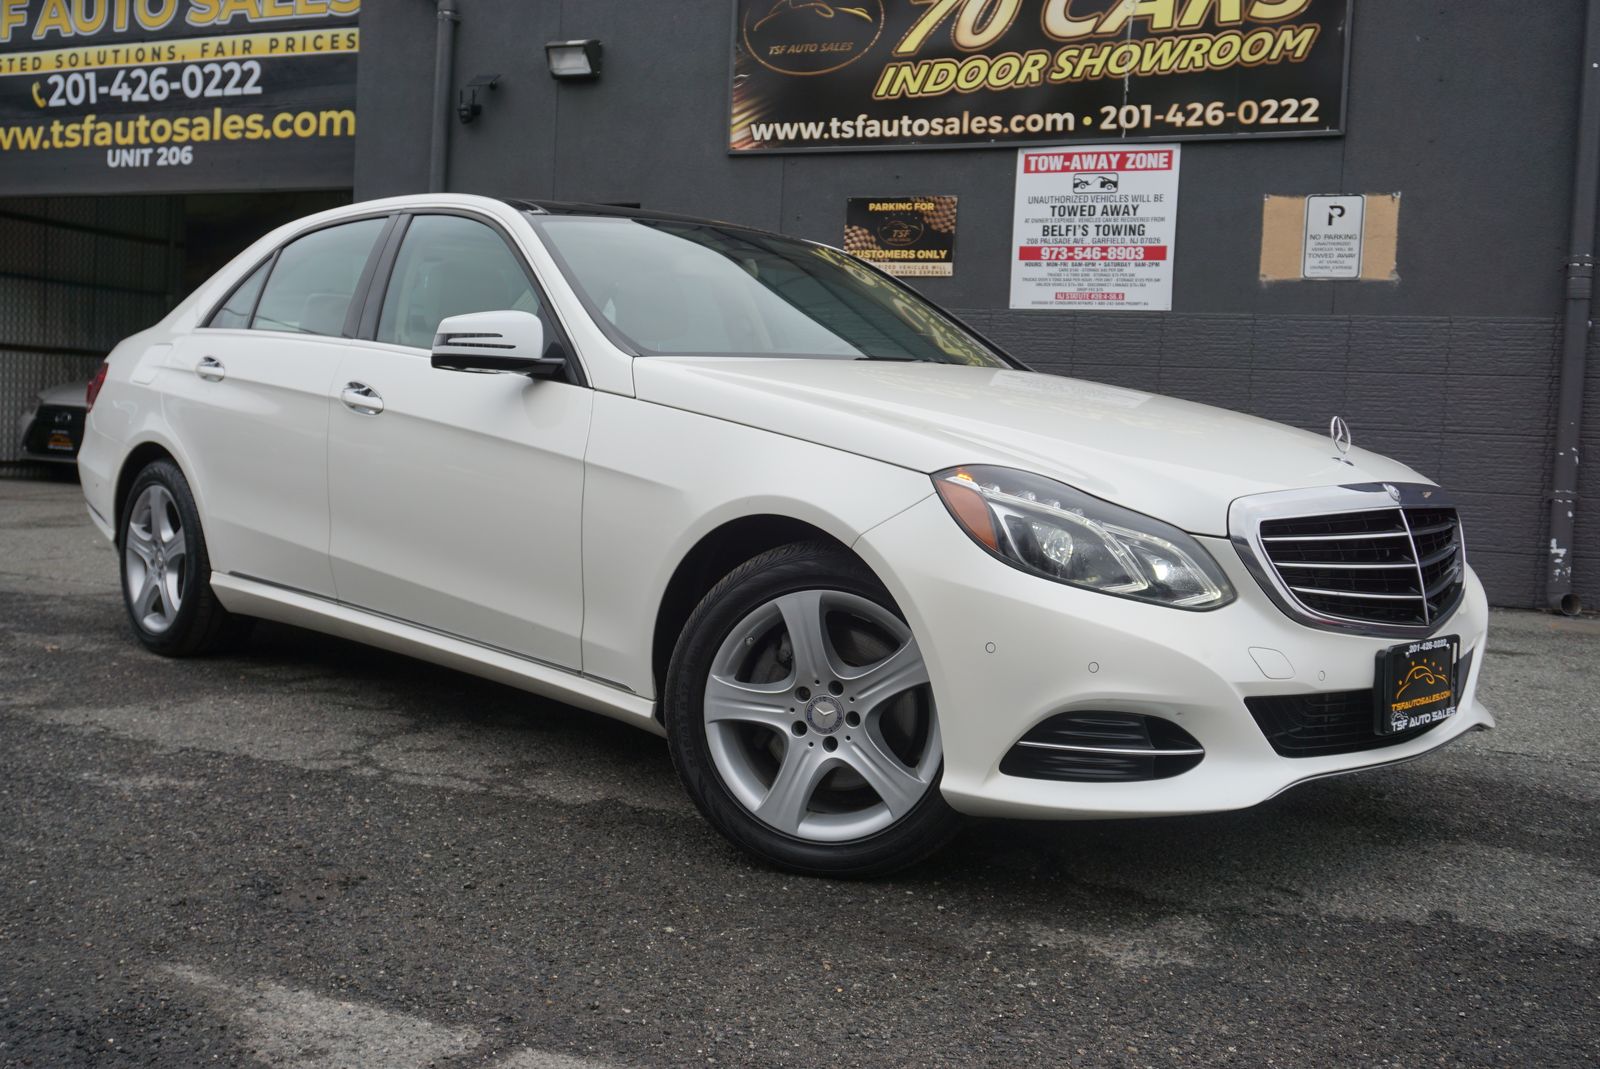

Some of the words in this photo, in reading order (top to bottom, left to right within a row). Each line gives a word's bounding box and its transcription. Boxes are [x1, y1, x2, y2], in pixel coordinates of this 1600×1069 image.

[32, 0, 178, 40] AUTO
[56, 45, 186, 69] SOLUTIONS,
[201, 39, 252, 57] FAIR
[269, 33, 357, 53] PRICES
[768, 45, 785, 55] TSF
[787, 43, 818, 54] AUTO
[819, 41, 854, 53] SALES
[874, 52, 1050, 99] INDOOR
[1049, 23, 1320, 83] SHOWROOM
[47, 61, 262, 107] 201-426-0222
[750, 110, 1075, 141] www.tsfautosales.com
[1099, 97, 1320, 130] 201-426-0222
[107, 148, 153, 168] UNIT
[156, 146, 193, 166] 206
[1028, 153, 1120, 172] TOW-AWAY
[1125, 152, 1169, 170] ZONE
[1028, 195, 1088, 204] UNAUTHORIZED
[1090, 194, 1129, 203] VEHICLES
[1131, 194, 1151, 203] WILL
[1153, 193, 1164, 202] BE
[868, 202, 913, 211] PARKING
[914, 202, 935, 211] FOR
[1050, 205, 1096, 217] TOWED
[1100, 204, 1140, 217] AWAY
[893, 229, 911, 238] TSF
[1042, 224, 1089, 237] BELFI'S
[1094, 224, 1146, 237] TOWING
[1310, 233, 1321, 241] NO
[851, 249, 916, 259] CUSTOMERS
[917, 249, 948, 259] ONLY
[1040, 247, 1145, 260] 973-546-8903
[1391, 719, 1408, 732] TSF
[1409, 713, 1431, 728] AUTO
[1431, 706, 1456, 722] SALES
